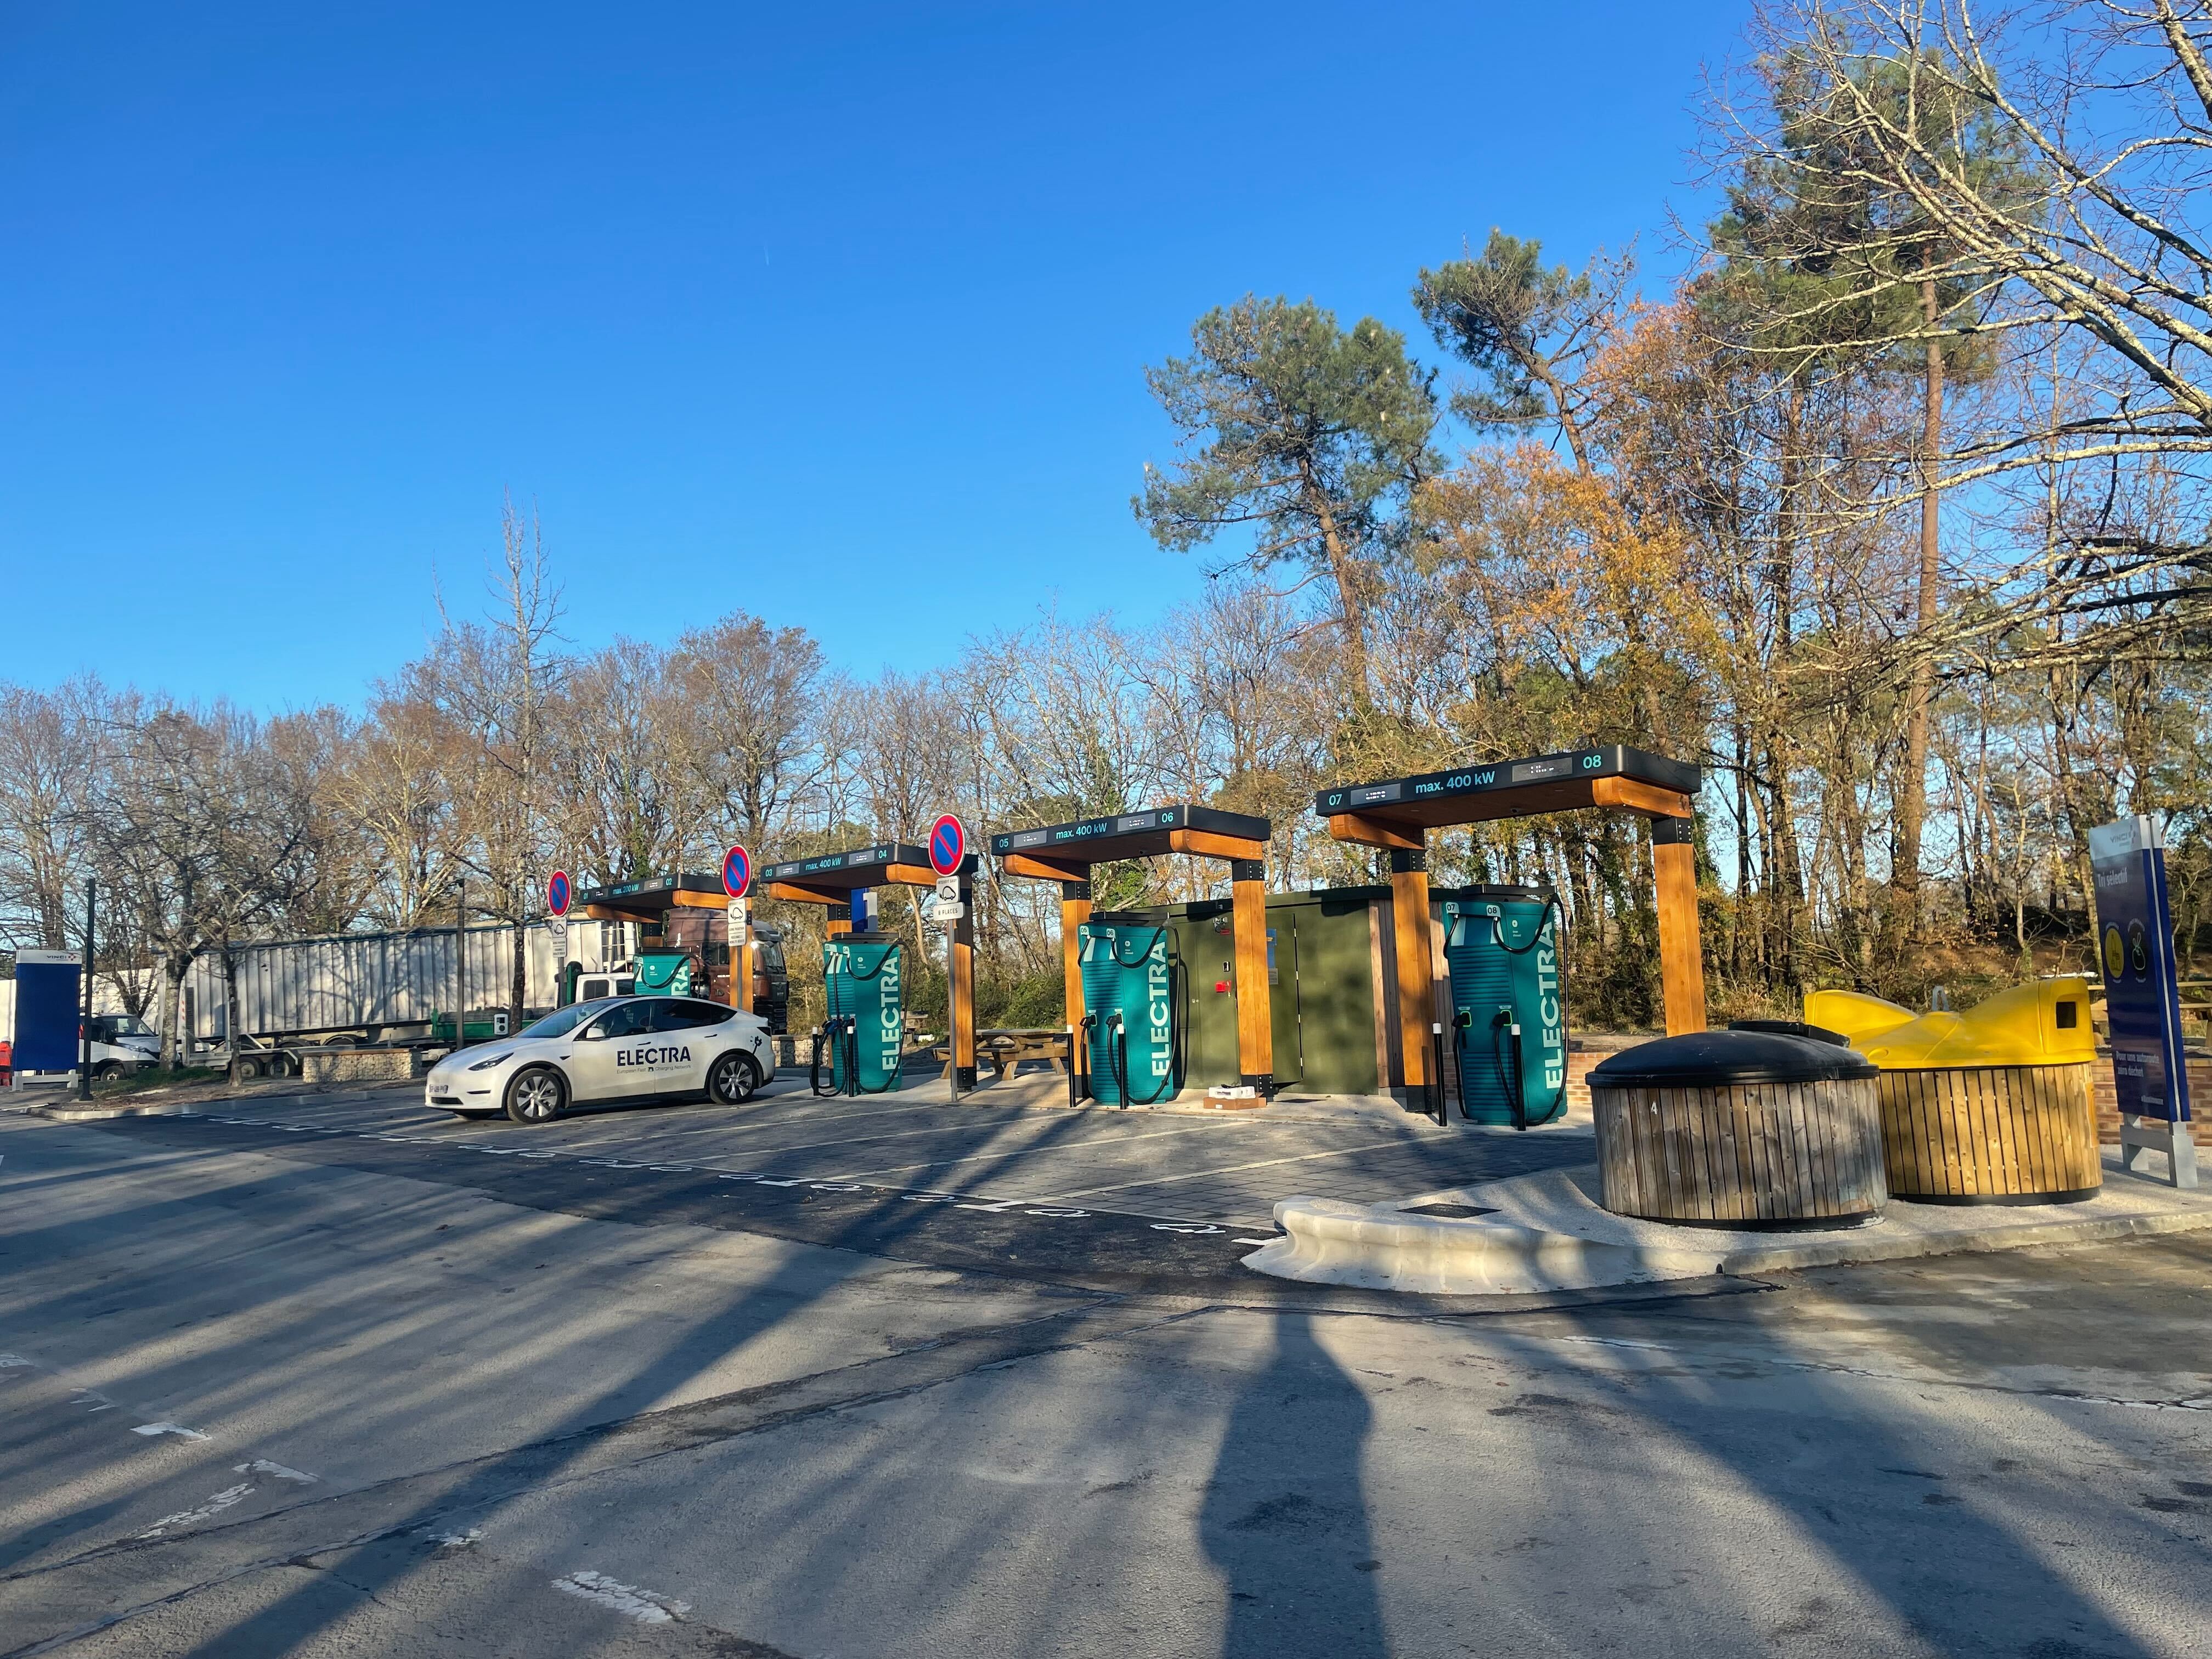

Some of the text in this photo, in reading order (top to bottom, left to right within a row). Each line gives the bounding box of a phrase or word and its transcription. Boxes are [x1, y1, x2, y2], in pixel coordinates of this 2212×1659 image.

[1328, 755, 1601, 806] 07 max. 400 kW 08
[999, 812, 1173, 848] 05 max. 400 kW 06
[765, 868, 773, 877] 03
[820, 859, 831, 868] 400
[832, 857, 842, 866] kW
[878, 850, 887, 859] 04
[2097, 867, 2128, 887] Tri sélectif
[623, 885, 631, 893] 200
[665, 878, 672, 886] 02
[881, 956, 900, 1070] ELECTRA
[1148, 941, 1170, 1076] ELECTRA
[1535, 921, 1563, 1089] ELECTRA
[617, 1046, 691, 1066] ELECTRA
